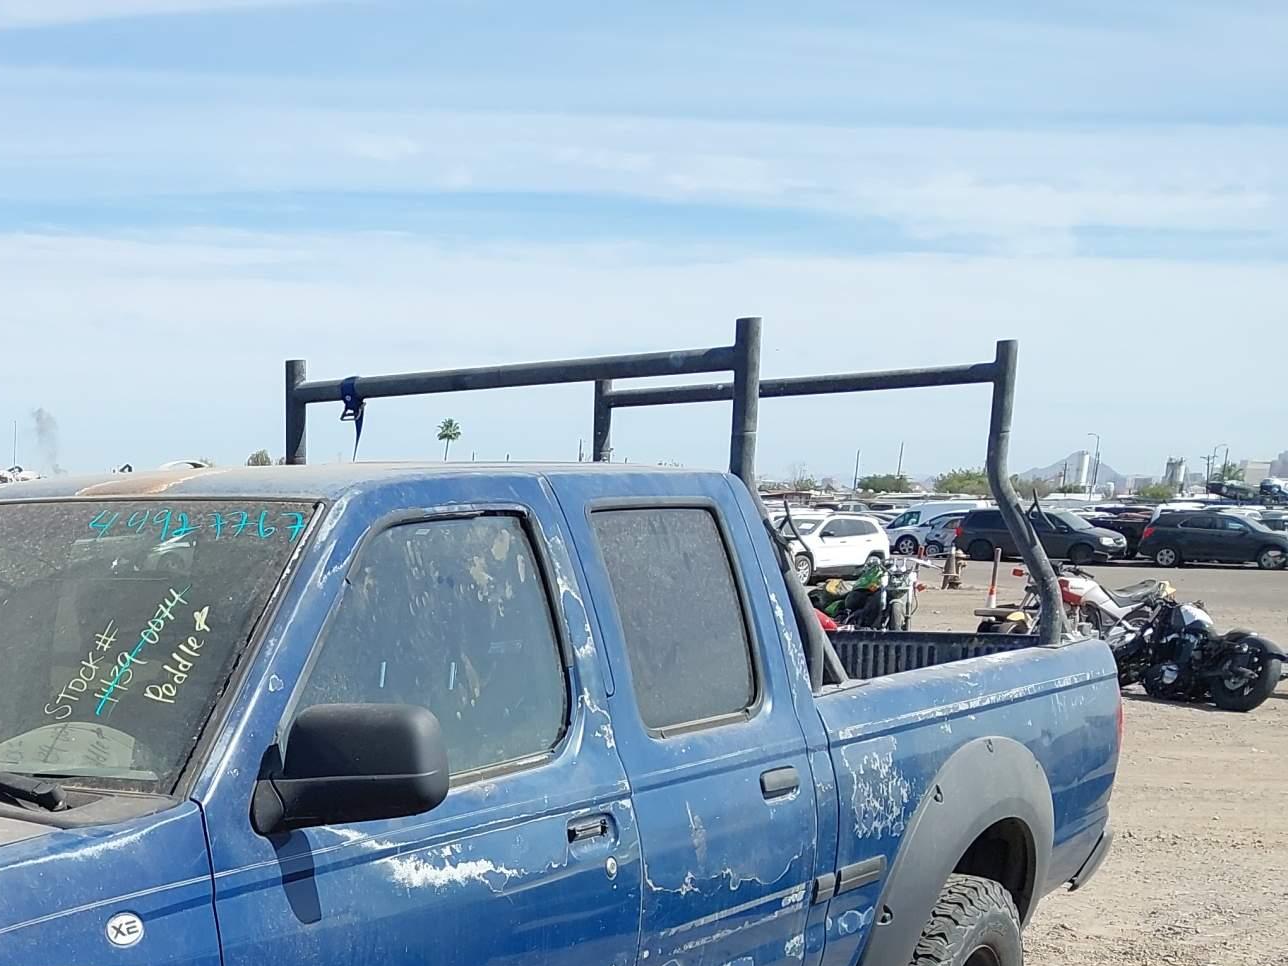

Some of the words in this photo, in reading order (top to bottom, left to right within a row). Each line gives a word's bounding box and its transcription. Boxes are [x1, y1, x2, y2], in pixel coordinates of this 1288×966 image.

[95, 619, 119, 652] #
[143, 636, 205, 704] Peddle
[111, 919, 140, 940] XE
